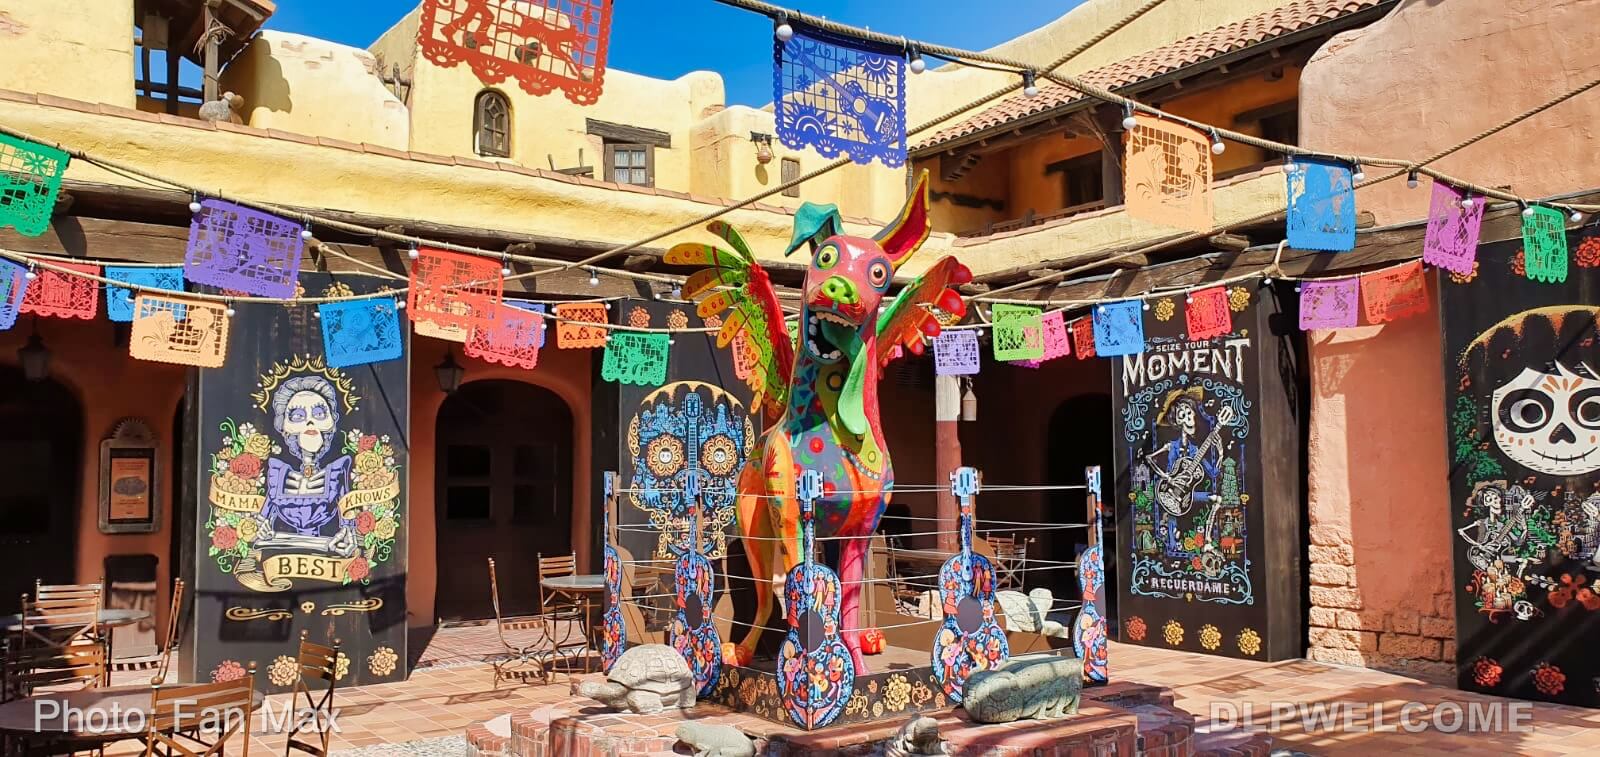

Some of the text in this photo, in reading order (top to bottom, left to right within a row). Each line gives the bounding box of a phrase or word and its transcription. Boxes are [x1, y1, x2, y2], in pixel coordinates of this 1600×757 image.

[1156, 340, 1210, 353] SEIZE YOUR
[1122, 338, 1251, 398] MOMENT
[215, 487, 391, 511] MAMA KNOWS
[278, 557, 342, 578] BEST
